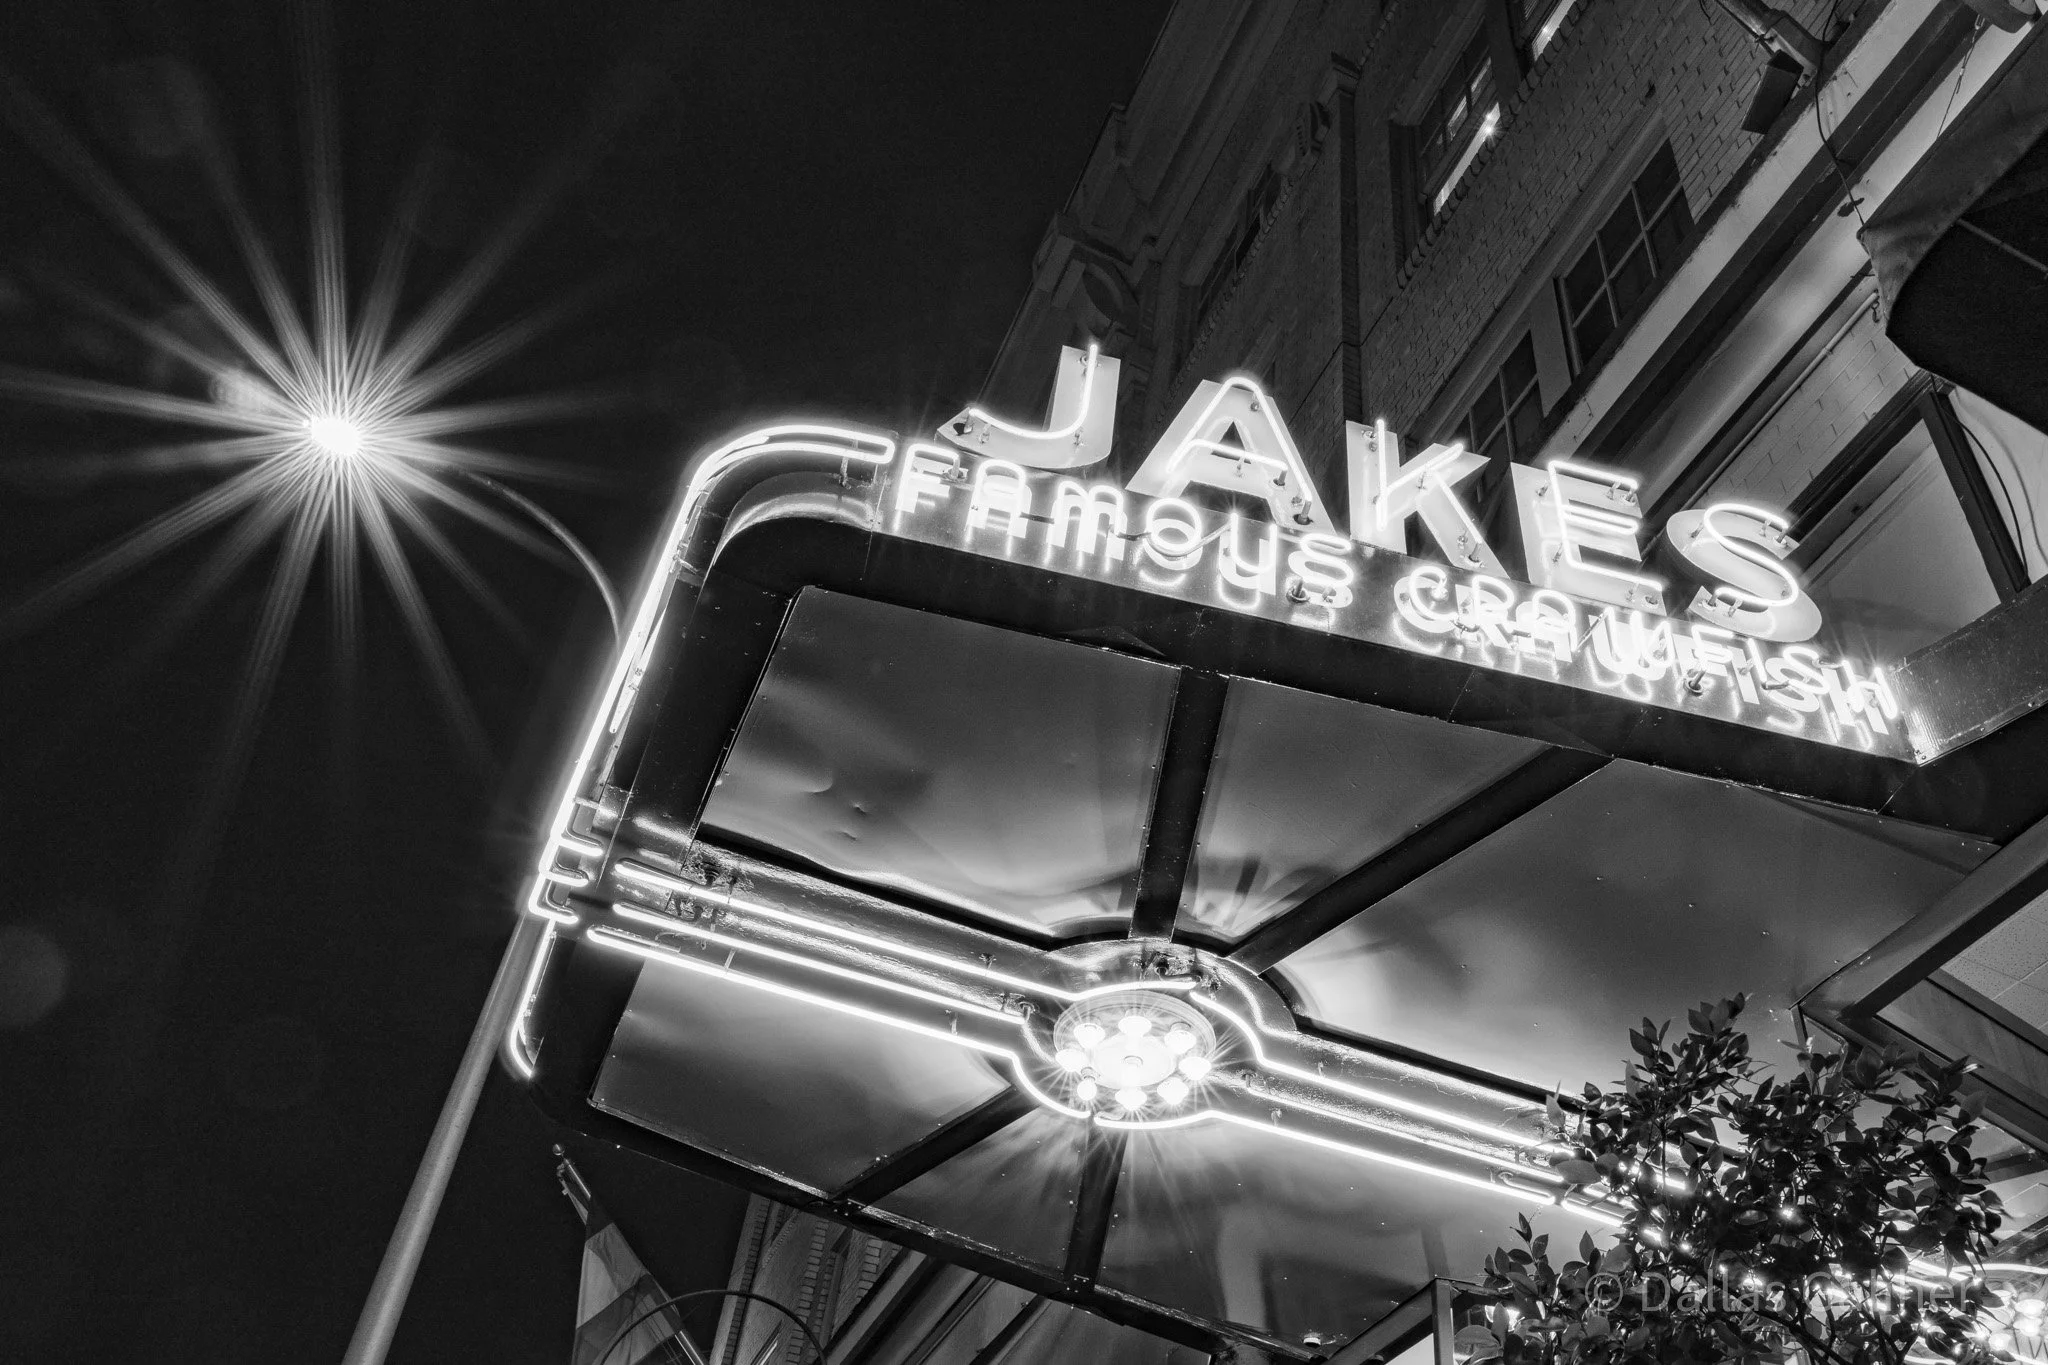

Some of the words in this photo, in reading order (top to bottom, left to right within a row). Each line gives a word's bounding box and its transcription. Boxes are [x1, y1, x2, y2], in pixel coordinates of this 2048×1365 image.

[894, 442, 1356, 620] FAMOUS
[1392, 564, 1900, 742] CRAWFISH
[936, 343, 1823, 642] JAKES
